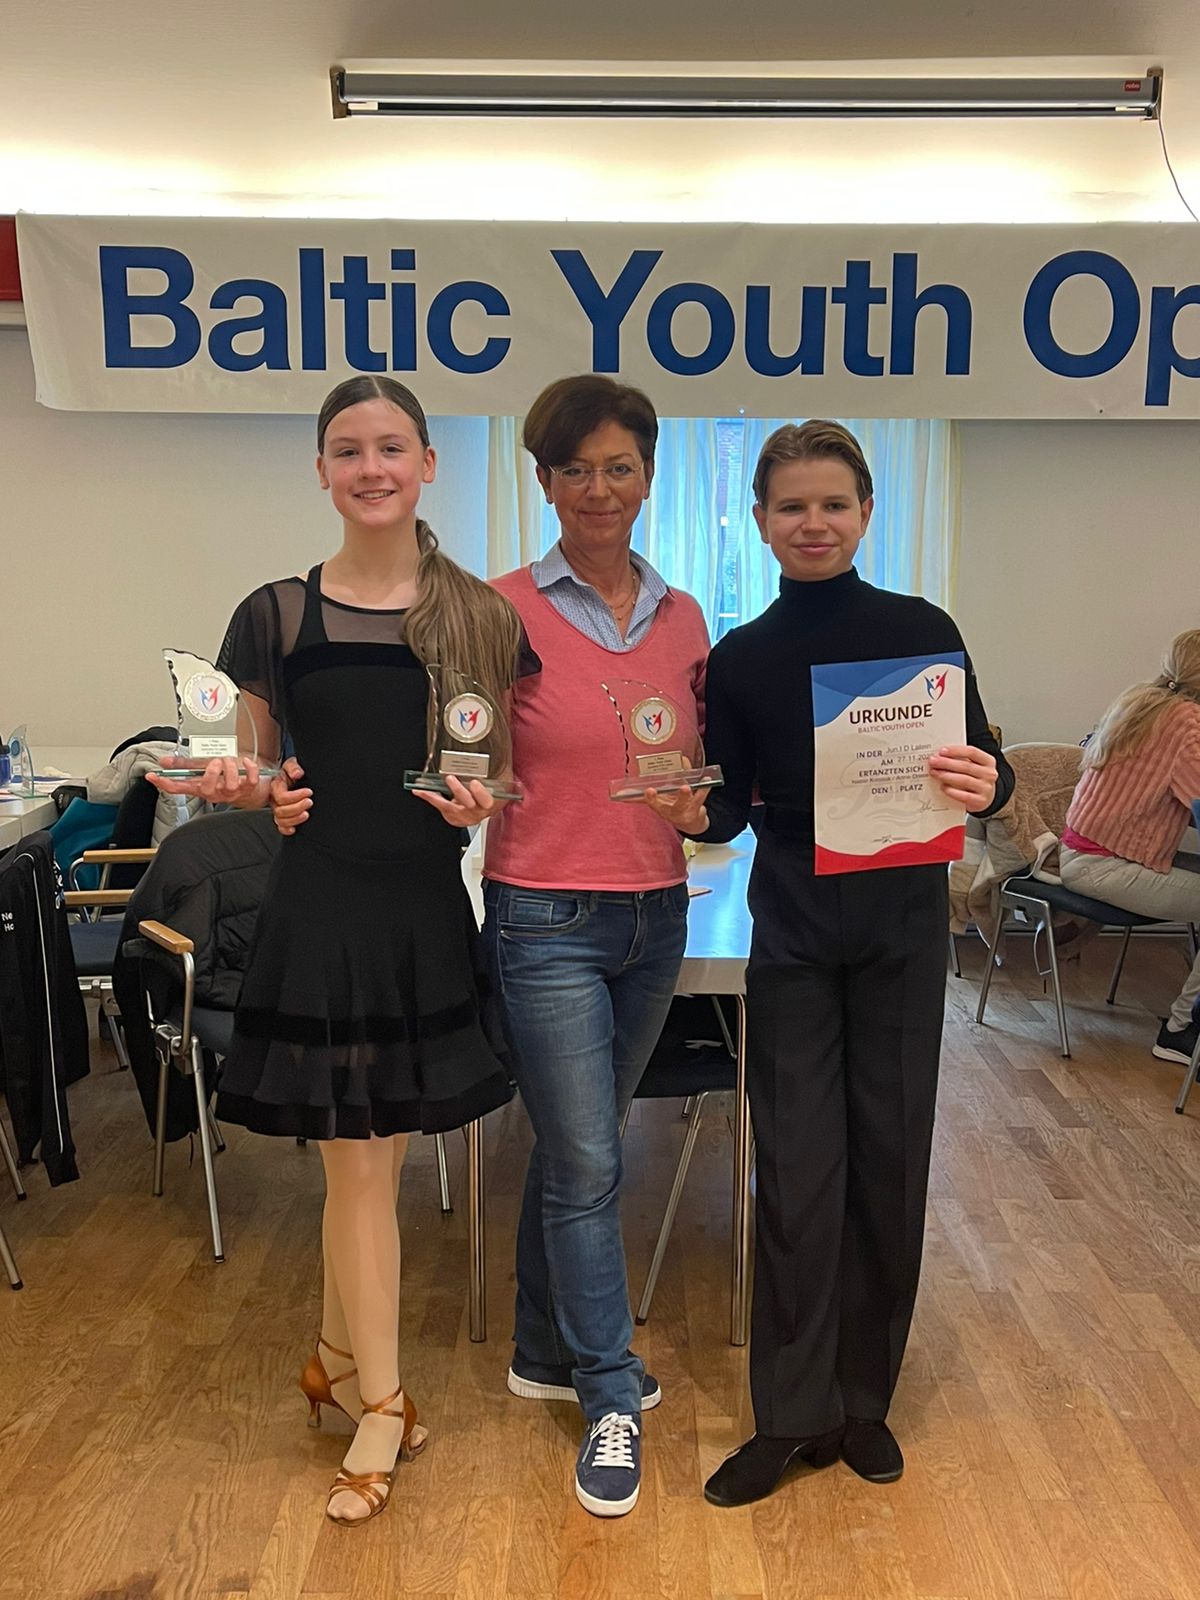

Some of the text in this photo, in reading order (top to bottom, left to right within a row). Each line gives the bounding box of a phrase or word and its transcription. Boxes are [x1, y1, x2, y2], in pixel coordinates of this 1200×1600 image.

[99, 245, 512, 374] Baltic
[550, 248, 973, 377] Youth
[849, 703, 933, 724] URKUNDE
[858, 721, 925, 734] BALTIC YOUTH OPEN
[856, 751, 865, 759] IN
[866, 750, 882, 758] DER
[880, 759, 893, 767] AM
[859, 766, 904, 778] ERTANZTEN
[905, 765, 924, 774] SICH
[871, 786, 889, 795] DEN
[899, 783, 923, 793] PLATZ
